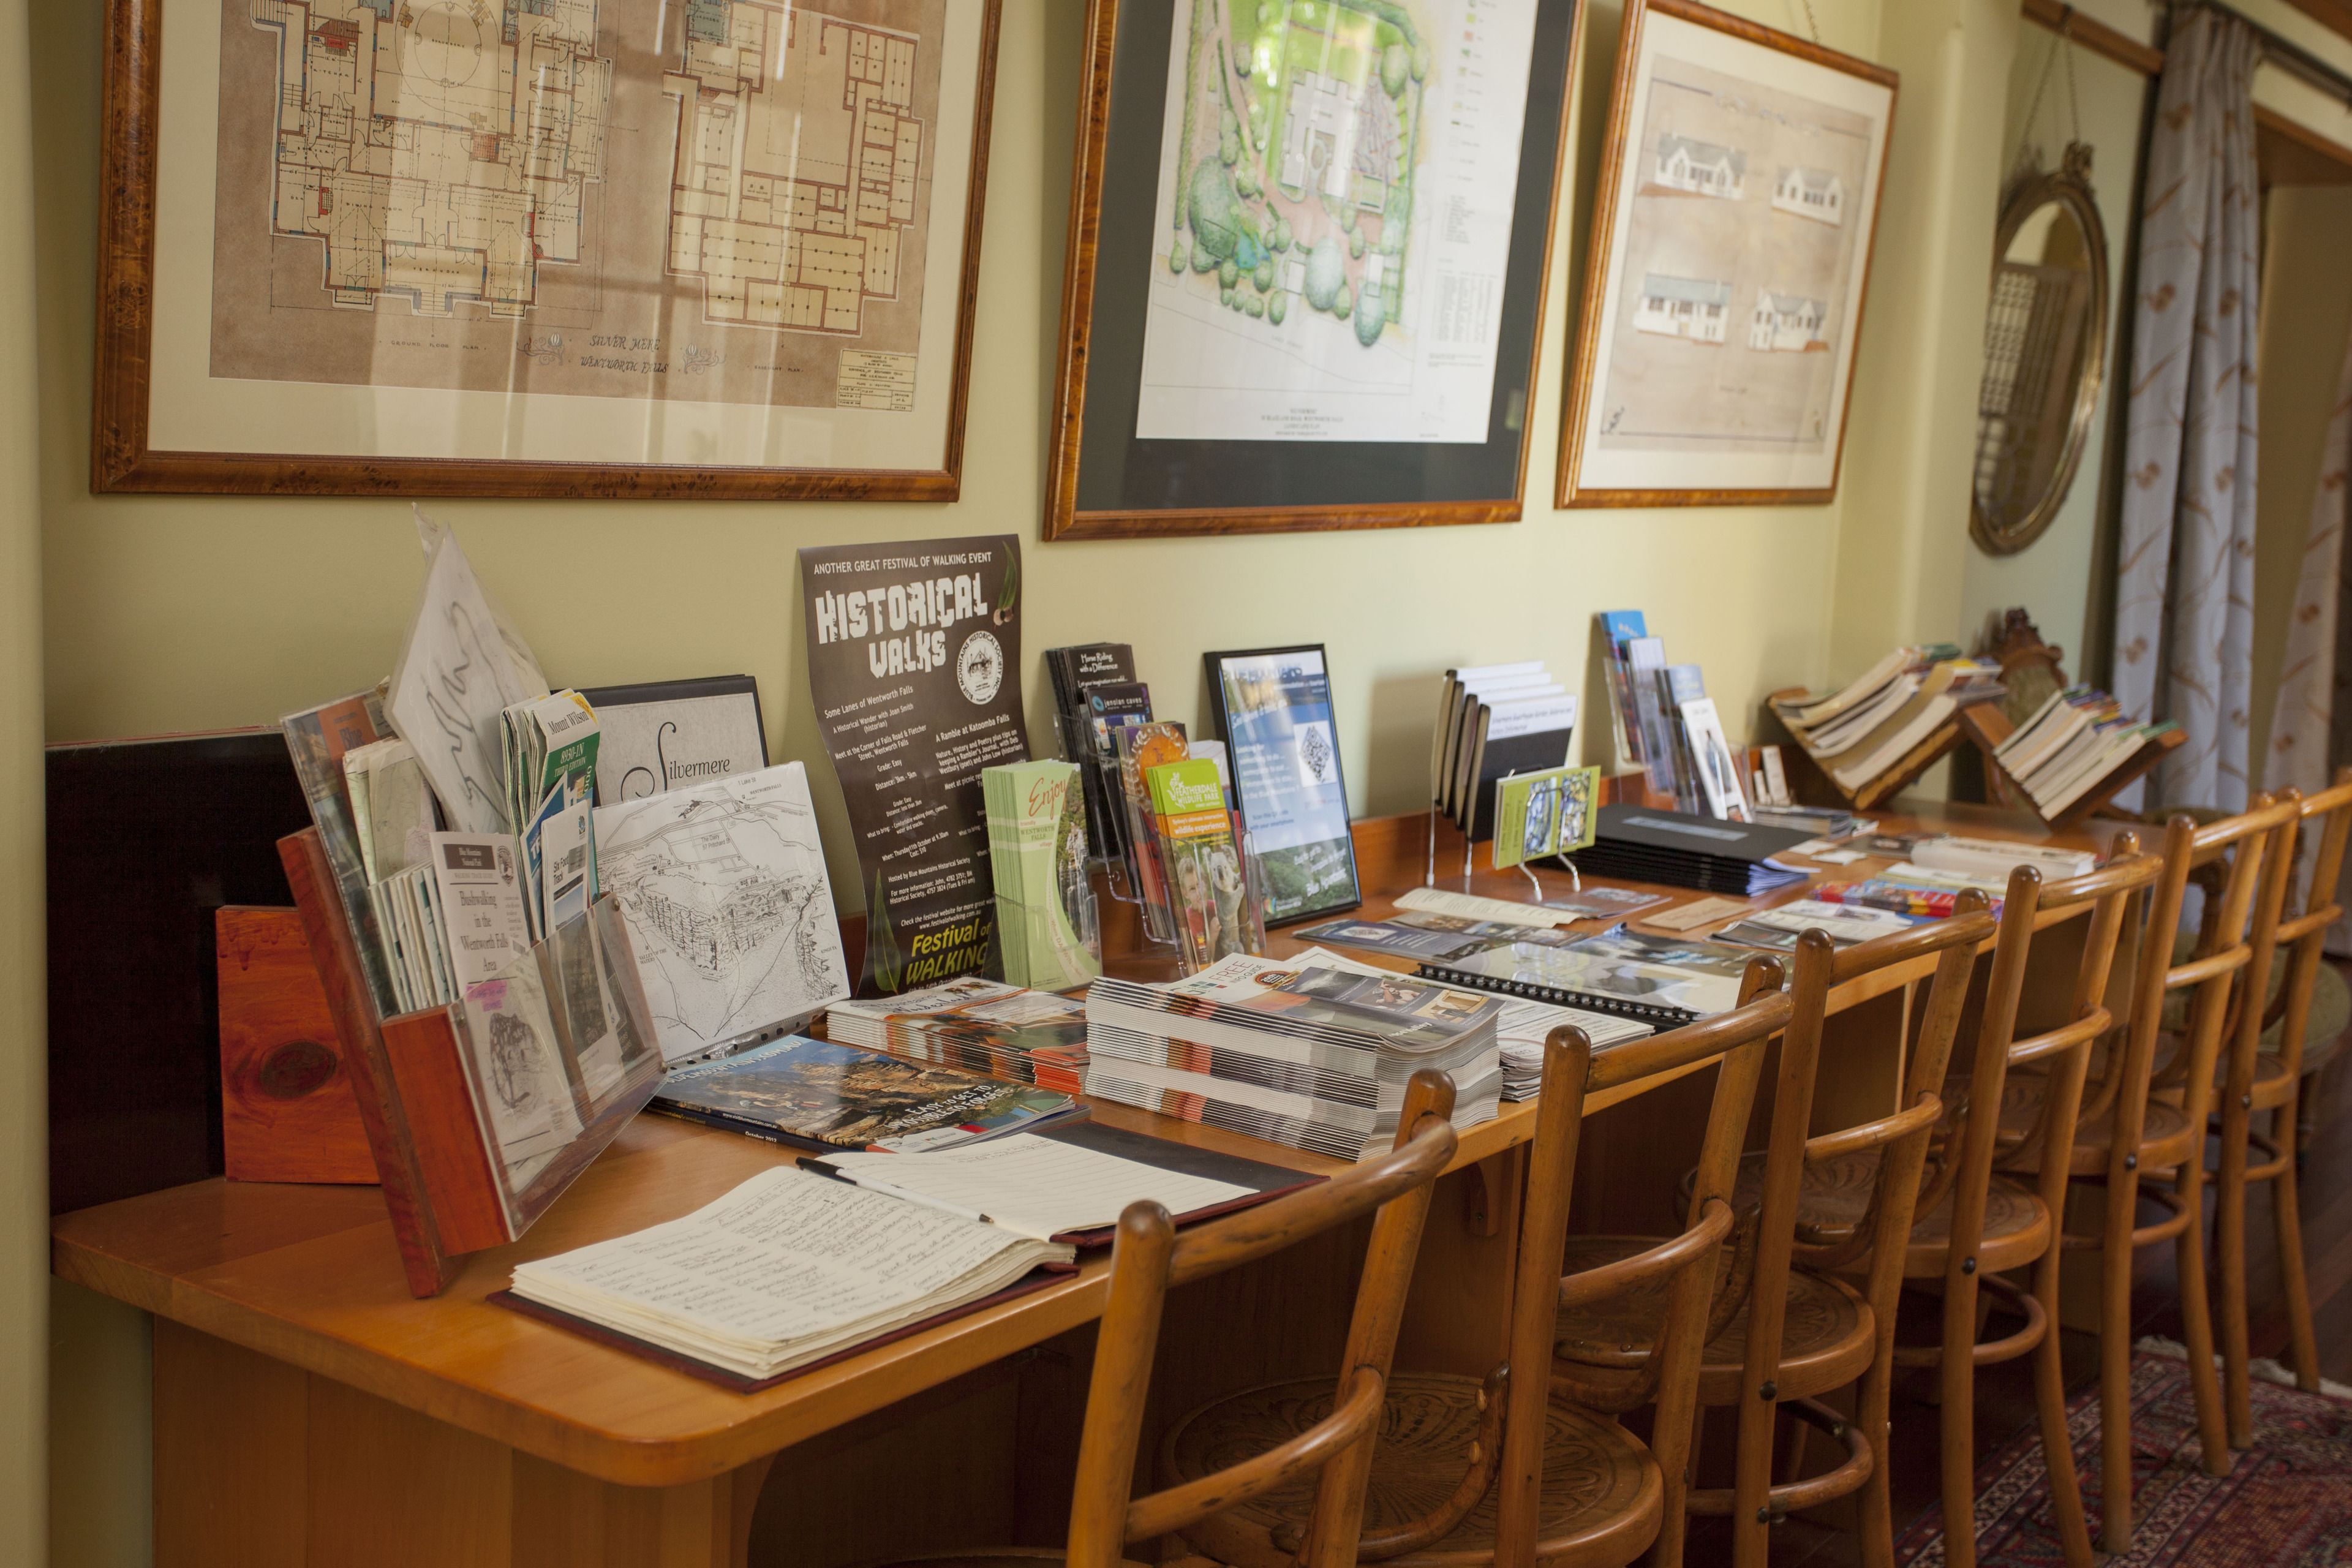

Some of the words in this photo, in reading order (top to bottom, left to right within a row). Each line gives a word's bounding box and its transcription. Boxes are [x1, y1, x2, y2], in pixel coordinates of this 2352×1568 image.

[589, 334, 626, 349] SILVER
[630, 338, 660, 352] MERE
[581, 356, 638, 372] WENTWORTH
[641, 362, 669, 374] FALLS
[814, 562, 851, 575] ANOTHER
[855, 559, 880, 571] GREAT
[883, 557, 918, 569] FESTIVAL
[921, 556, 930, 567] OF
[932, 554, 966, 565] WALKING
[970, 552, 992, 563] EVENT
[815, 573, 987, 644] HISTORICAL
[970, 633, 995, 646] HISTORICAL
[869, 630, 946, 679] WALKS
[1081, 654, 1096, 663] Horse
[1096, 652, 1113, 662] Riding
[958, 643, 969, 686] MOUNTAINS
[1091, 662, 1118, 673] Difference
[963, 685, 973, 699] BLUE
[824, 708, 840, 718] Some
[842, 703, 858, 714] Lanes
[860, 699, 865, 708] of
[867, 690, 898, 706] Wentworth
[899, 685, 913, 696] Falls
[1104, 699, 1125, 708] jenolan
[548, 717, 570, 735] Mount
[567, 710, 589, 726] Wilson
[838, 720, 859, 733] Historical
[859, 715, 877, 725] Wander
[889, 708, 900, 717] Joan
[901, 703, 913, 712] Smith
[864, 720, 887, 734] (historian)
[941, 729, 961, 741] Ramble
[969, 719, 996, 732] Katoomba
[997, 714, 1009, 724] Falls
[835, 751, 846, 760] Meet
[860, 742, 875, 752] Corner
[893, 732, 903, 741] Road
[908, 725, 926, 735] Fletcher
[936, 750, 953, 759] Nature,
[953, 744, 969, 753] History
[978, 737, 992, 745] Poetry
[560, 742, 584, 764] 8930-1N
[858, 752, 875, 761] Street,
[874, 744, 898, 755] Wentworth
[939, 764, 959, 775] Westbury
[960, 760, 973, 770] (poet)
[1001, 744, 1023, 757] (historian)
[939, 757, 957, 766] keeping
[554, 764, 568, 778] THIRD
[568, 756, 587, 771] EDITION
[620, 722, 731, 802] Silvermere
[877, 763, 891, 772] Grade:
[892, 760, 902, 768] Easy
[750, 786, 771, 795] WENTWORTH
[875, 779, 894, 791] Distance:
[944, 782, 956, 791] Meet
[962, 774, 975, 786] picnic
[1175, 783, 1218, 796] FEATHERDALE
[1029, 777, 1068, 820] Enjoy
[1177, 793, 1203, 804] WILDLIFE
[1204, 792, 1219, 801] PARK
[1020, 826, 1054, 835] WENTWORTH
[1175, 825, 1194, 834] wildlife
[1195, 823, 1226, 833] experience
[708, 840, 726, 848] Pritchard
[918, 839, 932, 849] October
[554, 873, 564, 886] Track
[889, 873, 902, 883] Hosted
[919, 865, 938, 875] Mountains
[938, 861, 956, 870] Historical
[910, 881, 934, 892] information:
[459, 890, 497, 909] Bushwalking
[889, 894, 910, 905] Historical
[910, 891, 926, 899] Society,
[473, 914, 481, 928] in
[481, 912, 492, 927] the
[901, 918, 914, 927] Check
[923, 911, 939, 920] festival
[940, 907, 956, 916] website
[919, 910, 981, 930] www.festivalofwalking.com.au
[461, 933, 496, 951] Wentworth
[496, 933, 509, 949] Falls
[911, 918, 979, 957] Festival
[981, 922, 992, 936] of
[483, 957, 497, 971] Area
[639, 952, 654, 961] VALLEY
[907, 942, 989, 986] WALKING
[1208, 960, 1254, 981] FREE
[1244, 965, 1265, 976] GUIDE
[884, 992, 971, 1012] Wonderland
[905, 1102, 944, 1115] EASY
[952, 1090, 978, 1101] GET
[722, 1112, 777, 1129] www.visitbluemountains.com.au
[883, 1109, 949, 1129] IMPOSSIBLE
[946, 1105, 968, 1115] TO
[745, 1131, 764, 1140] October
